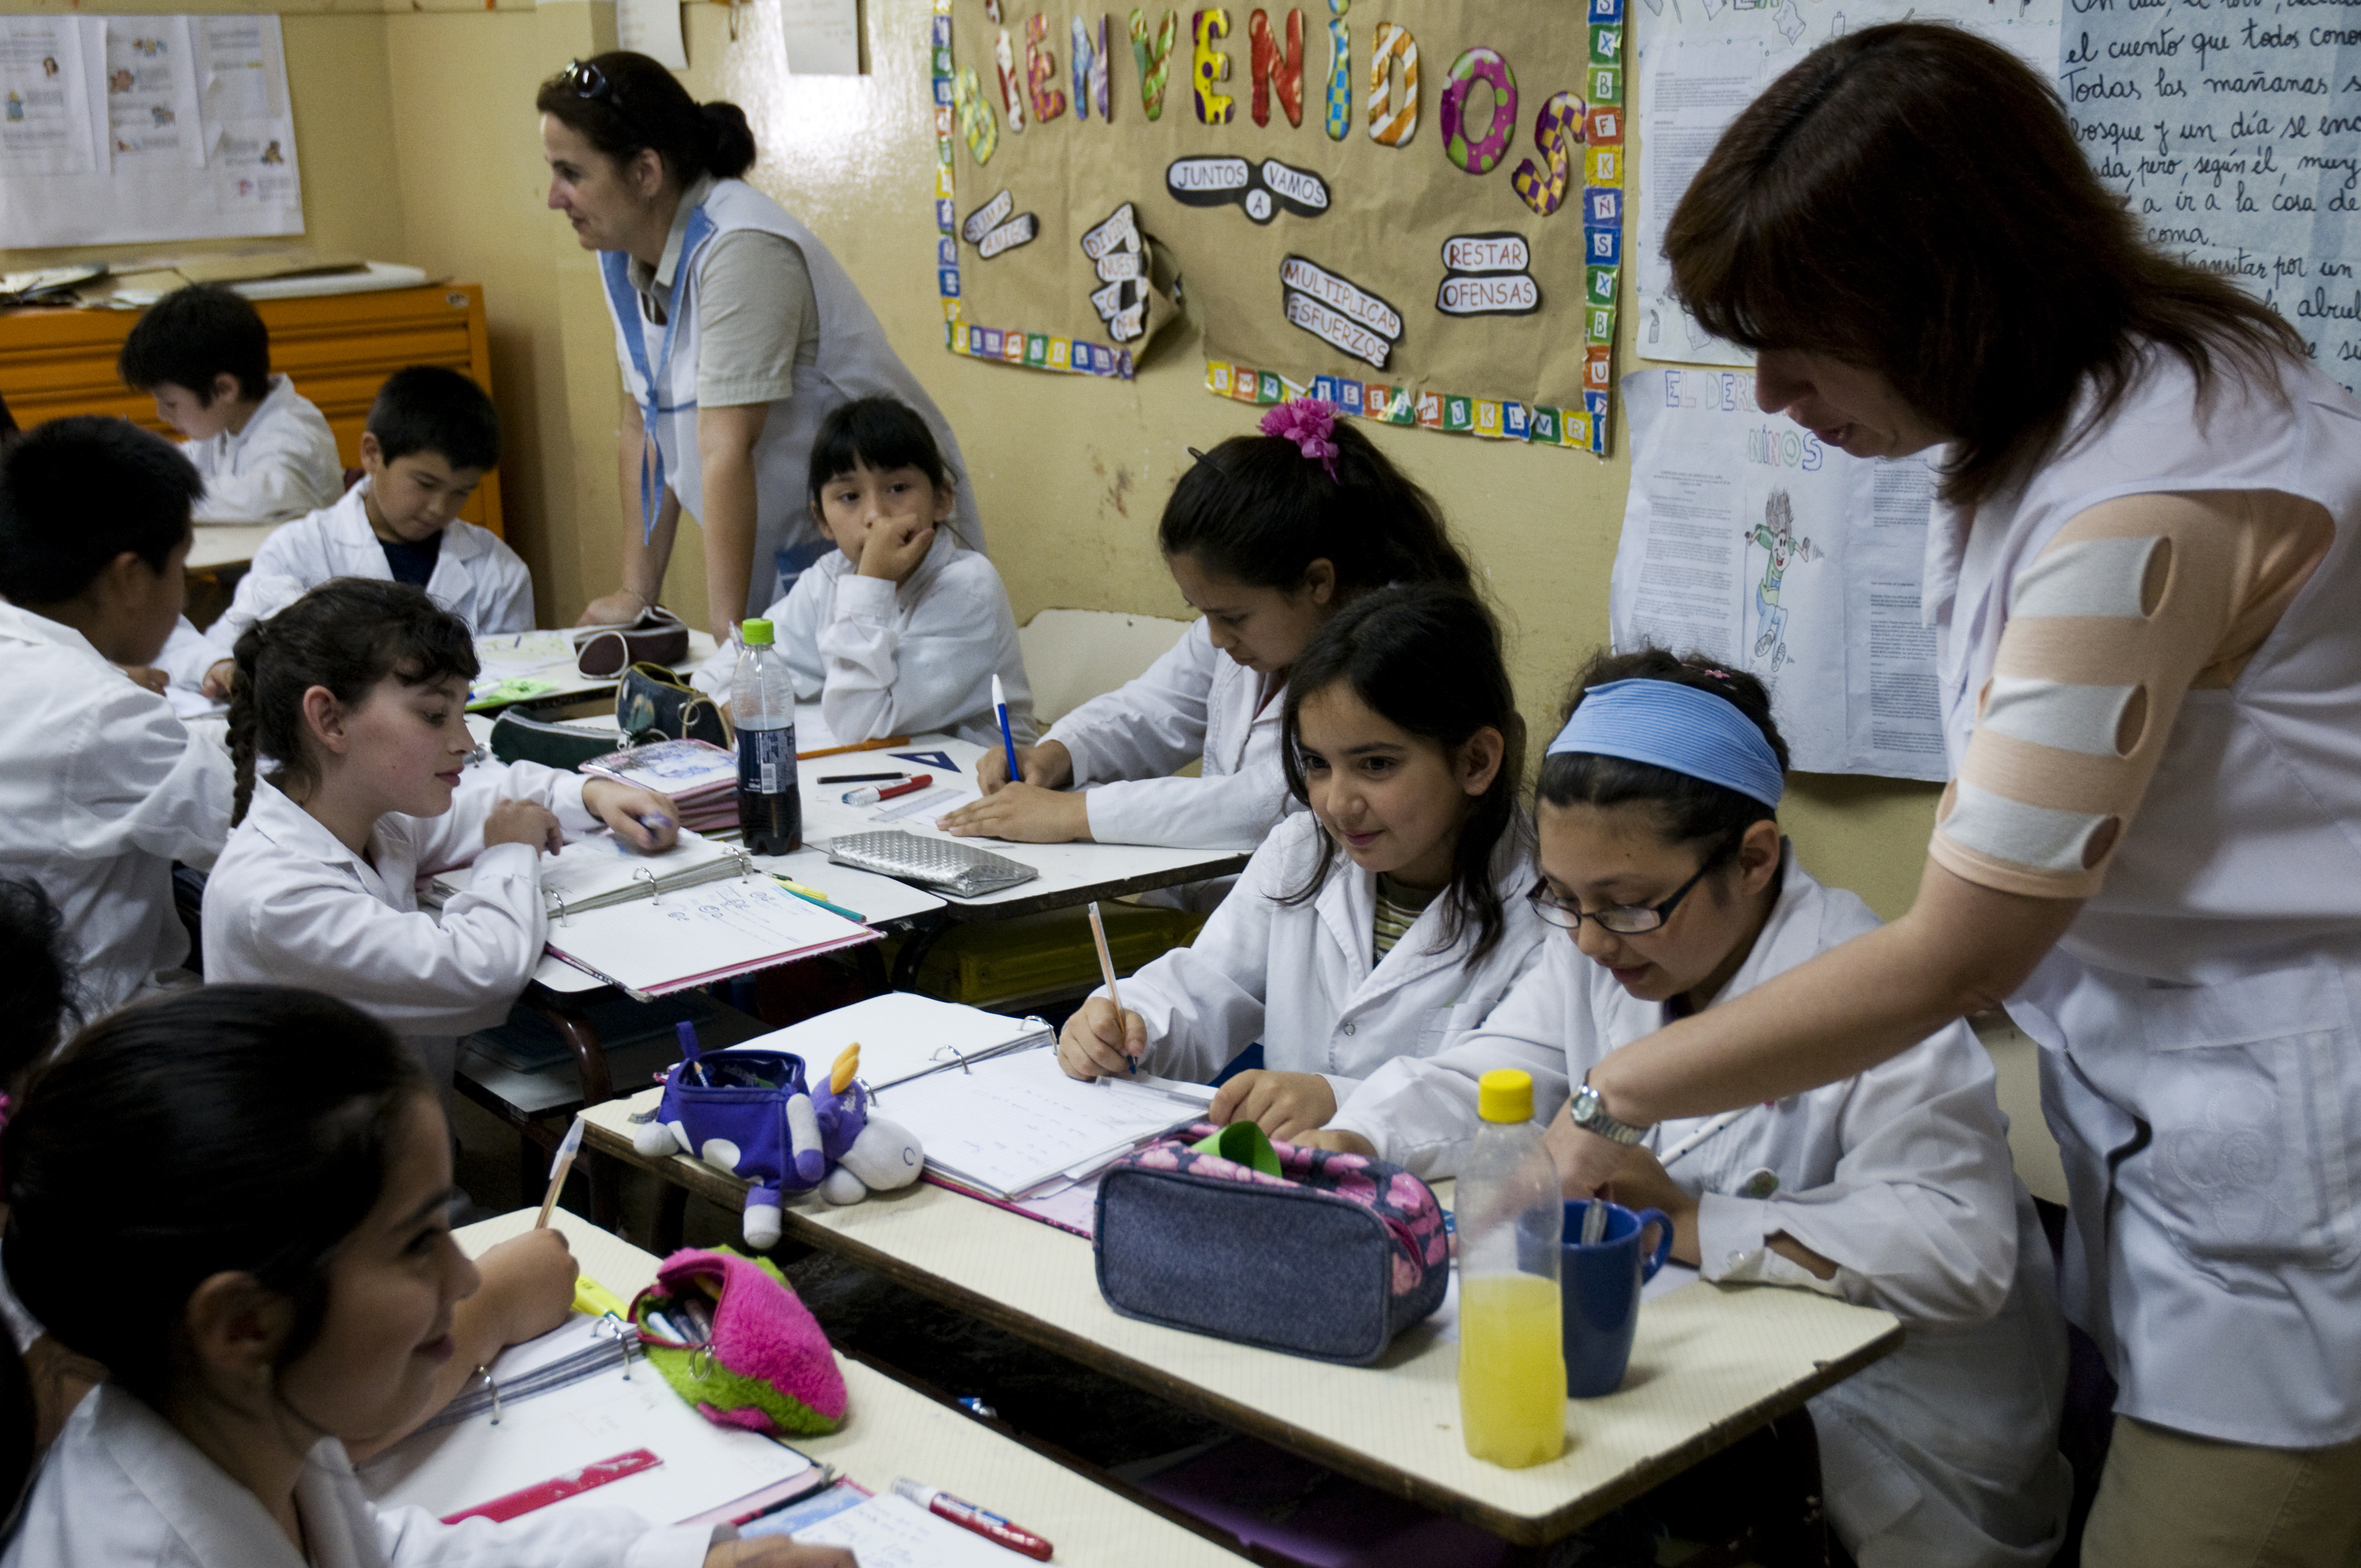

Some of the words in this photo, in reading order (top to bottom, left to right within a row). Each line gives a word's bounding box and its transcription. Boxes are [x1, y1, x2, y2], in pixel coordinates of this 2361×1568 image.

[2066, 31, 2098, 63] el
[2108, 27, 2185, 58] cuento
[2191, 33, 2229, 71] que
[2240, 18, 2299, 49] todos
[2060, 67, 2141, 102] Todas
[2155, 67, 2186, 97] las
[2204, 71, 2327, 95] mañanas
[2070, 117, 2145, 155] bosque
[2154, 120, 2169, 157] y
[2180, 124, 2216, 142] un
[2231, 111, 2274, 138] día
[2280, 115, 2309, 138] se
[1178, 166, 1245, 187] JUNTOS
[1270, 165, 1324, 205] VAMOS
[2194, 149, 2245, 188] según
[2297, 156, 2361, 189] muy
[1253, 195, 1263, 214] A
[2143, 198, 2161, 214] a
[2176, 192, 2196, 211] ir
[2205, 194, 2221, 210] a
[2235, 180, 2259, 212] la
[2328, 188, 2360, 211] de
[1449, 244, 1524, 267] RESTAR
[2272, 256, 2307, 290] por
[2319, 262, 2353, 279] un
[1285, 263, 1397, 335] MULTIPLICAR
[1444, 281, 1533, 308] OFENSAS
[1288, 298, 1388, 364] ESFUERZOS
[1665, 370, 1696, 408] EL
[1706, 372, 1758, 412] DERE
